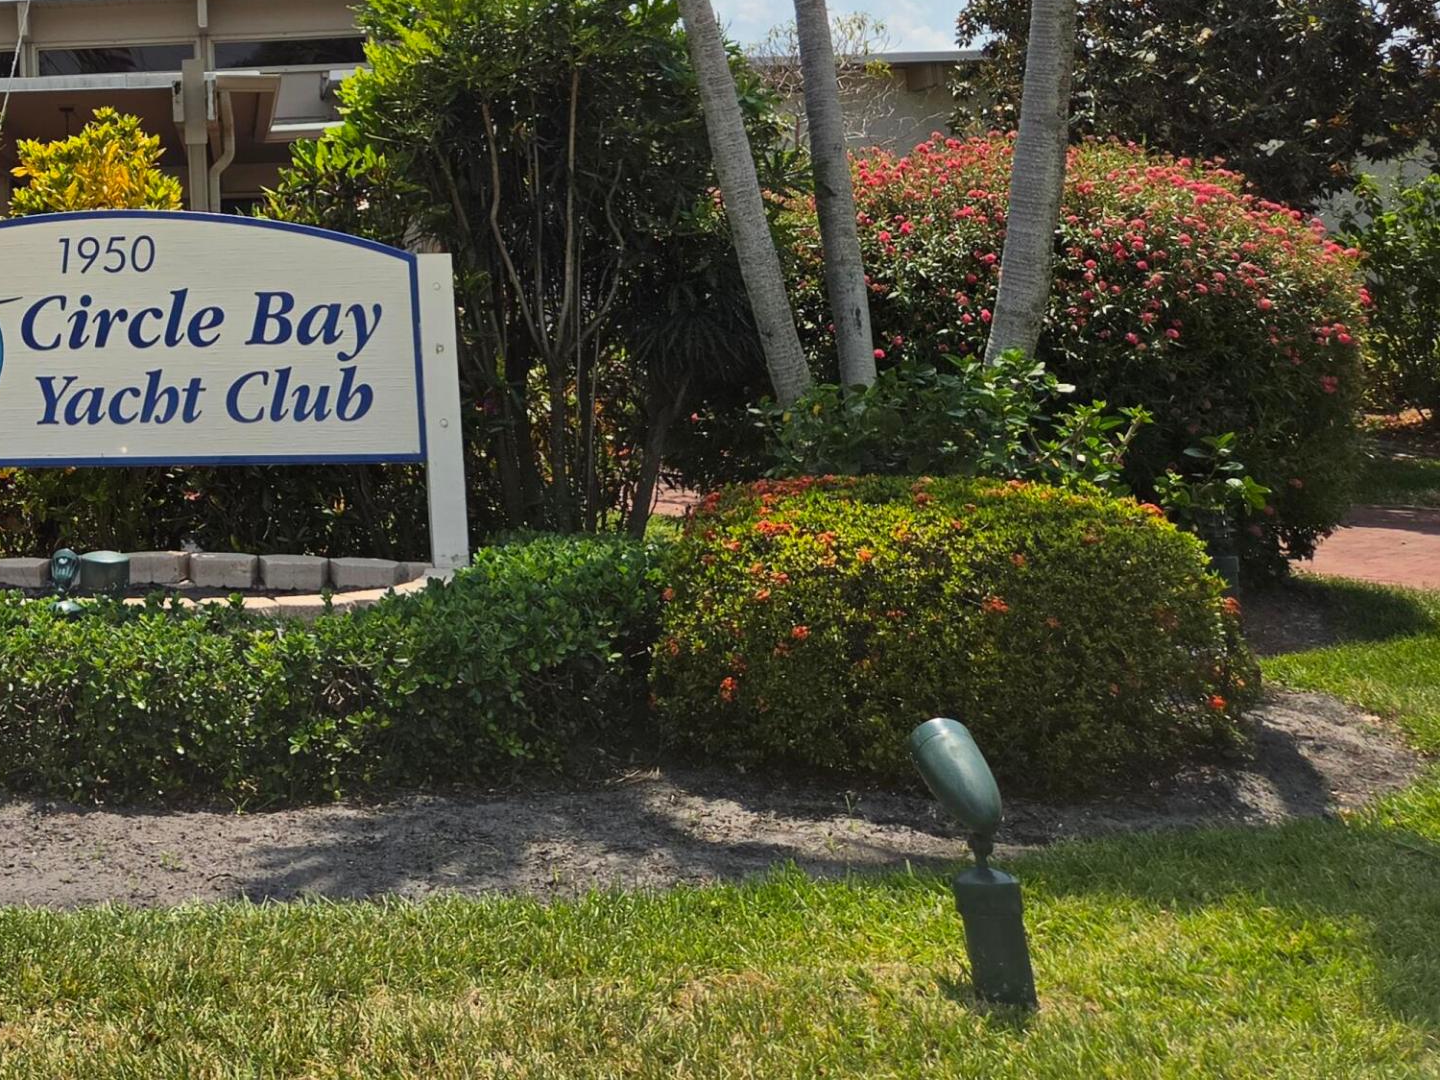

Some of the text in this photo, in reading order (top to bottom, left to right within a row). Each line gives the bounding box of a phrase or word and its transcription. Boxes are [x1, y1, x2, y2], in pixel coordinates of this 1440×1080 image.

[58, 234, 156, 274] 1950
[20, 287, 383, 362] Circle Bay
[34, 365, 374, 426] Yacht Club
